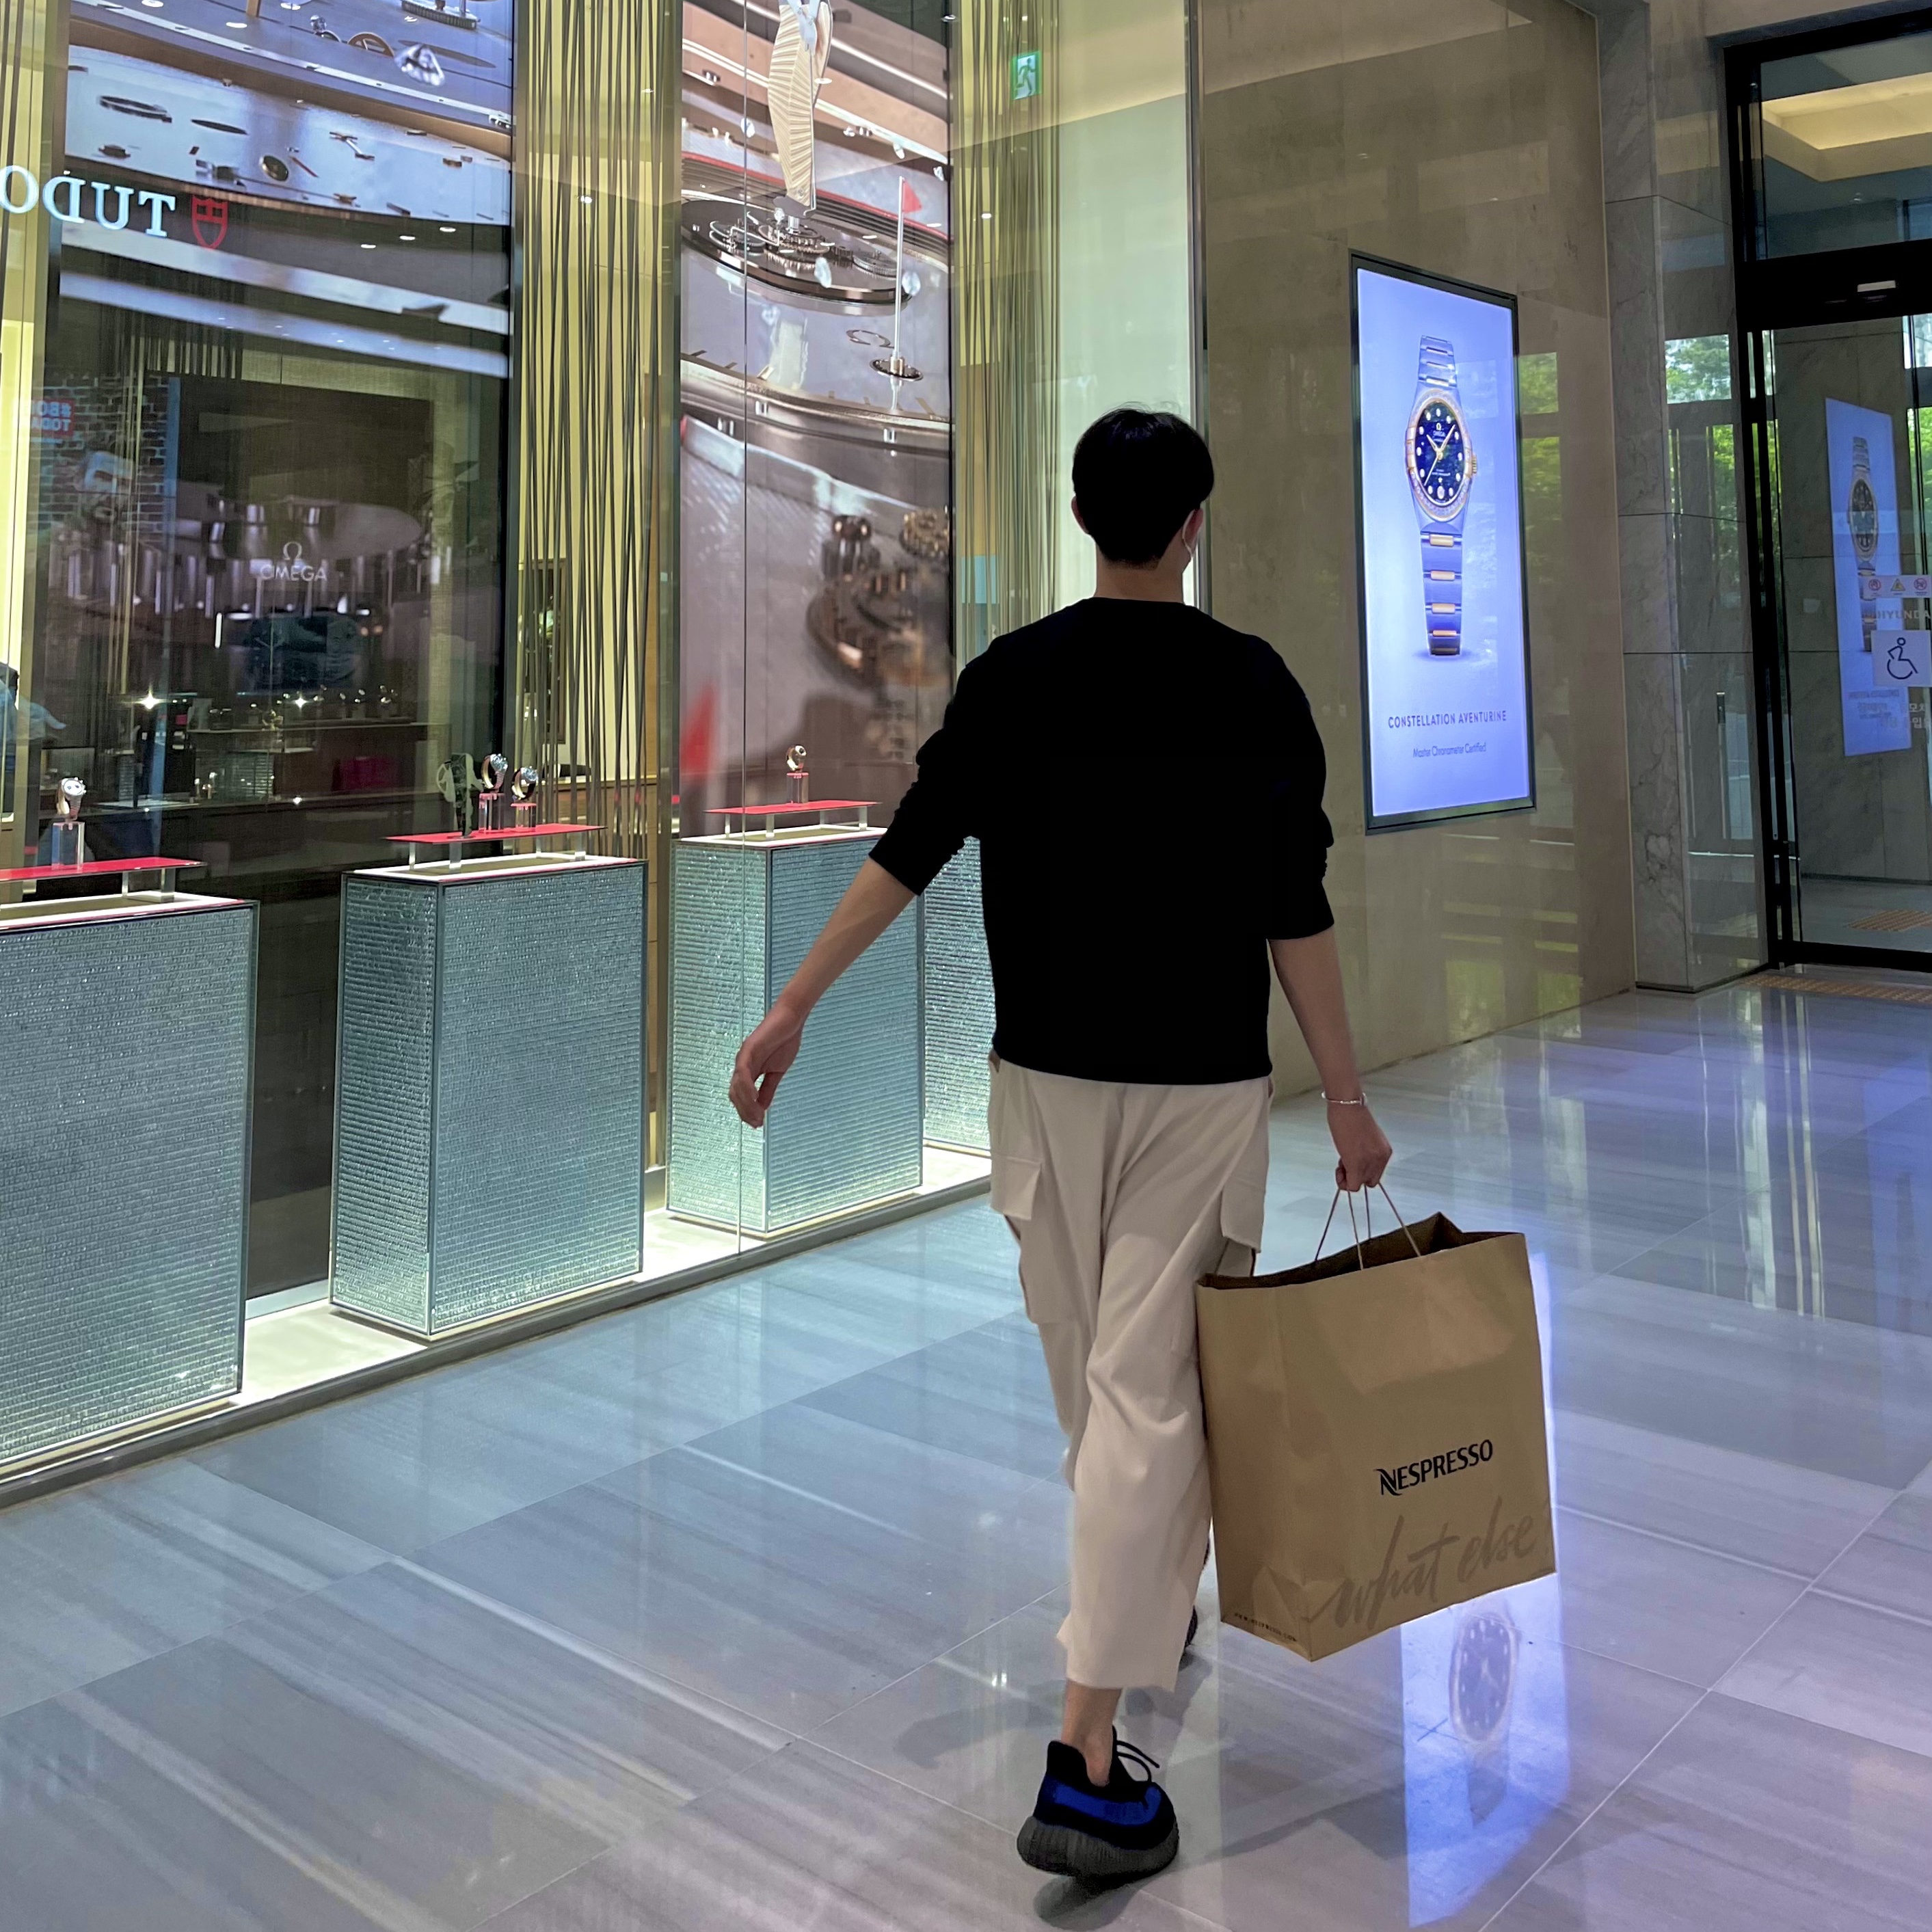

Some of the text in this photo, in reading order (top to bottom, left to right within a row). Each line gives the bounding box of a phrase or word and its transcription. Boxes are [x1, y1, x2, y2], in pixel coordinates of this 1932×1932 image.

[260, 564, 327, 581] OMEGA
[1388, 710, 1507, 729] CONSTELLATION AVENTURINE
[1412, 748, 1431, 757] Master
[1464, 742, 1486, 754] Certified
[1373, 1439, 1494, 1496] NESPRESSO
[1304, 1514, 1460, 1631] what
